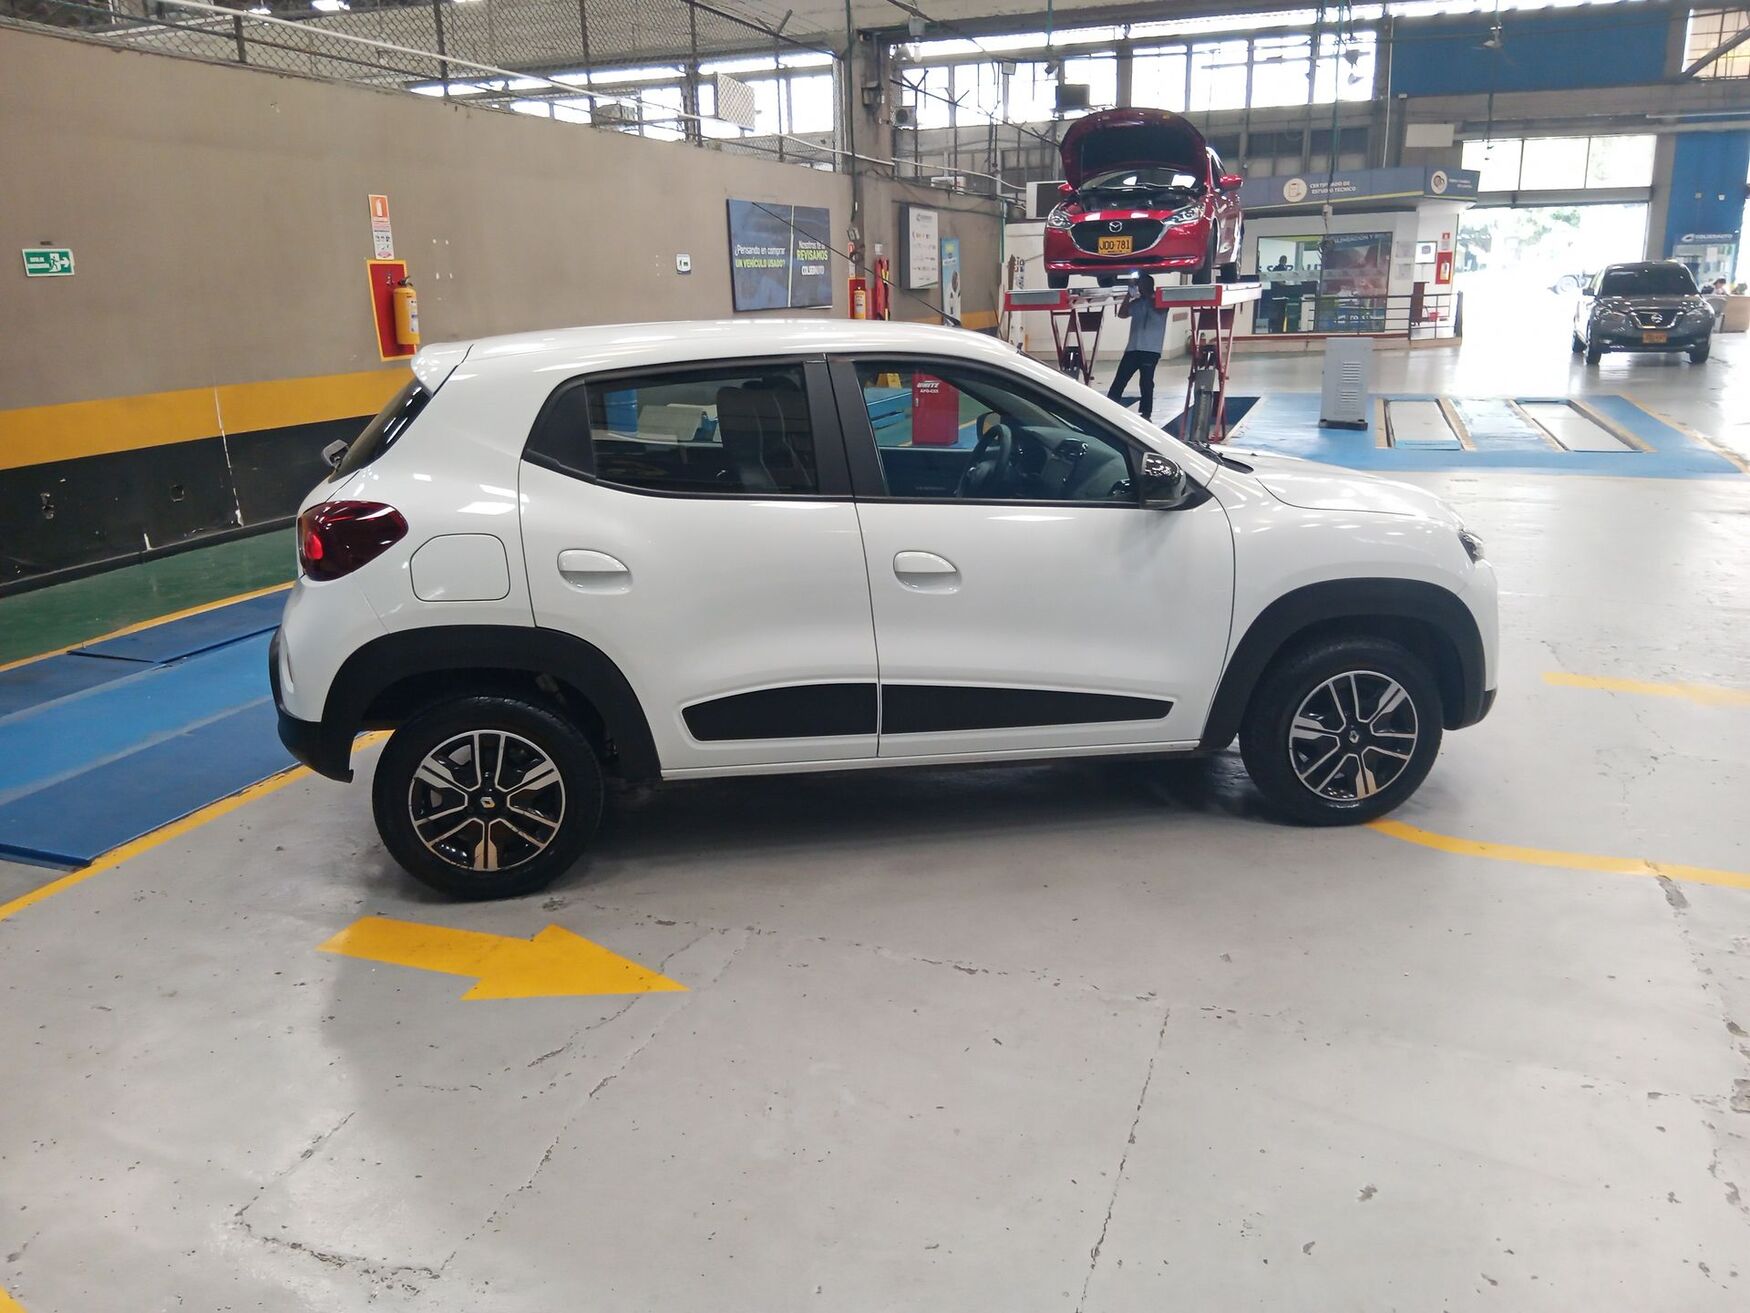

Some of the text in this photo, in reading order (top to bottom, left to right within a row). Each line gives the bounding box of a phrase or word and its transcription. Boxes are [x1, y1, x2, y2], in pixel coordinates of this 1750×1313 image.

[1310, 181, 1342, 189] CERTIFIADO
[735, 244, 785, 256] ¿Pensando en comprar
[797, 250, 828, 261] REVISAMOS
